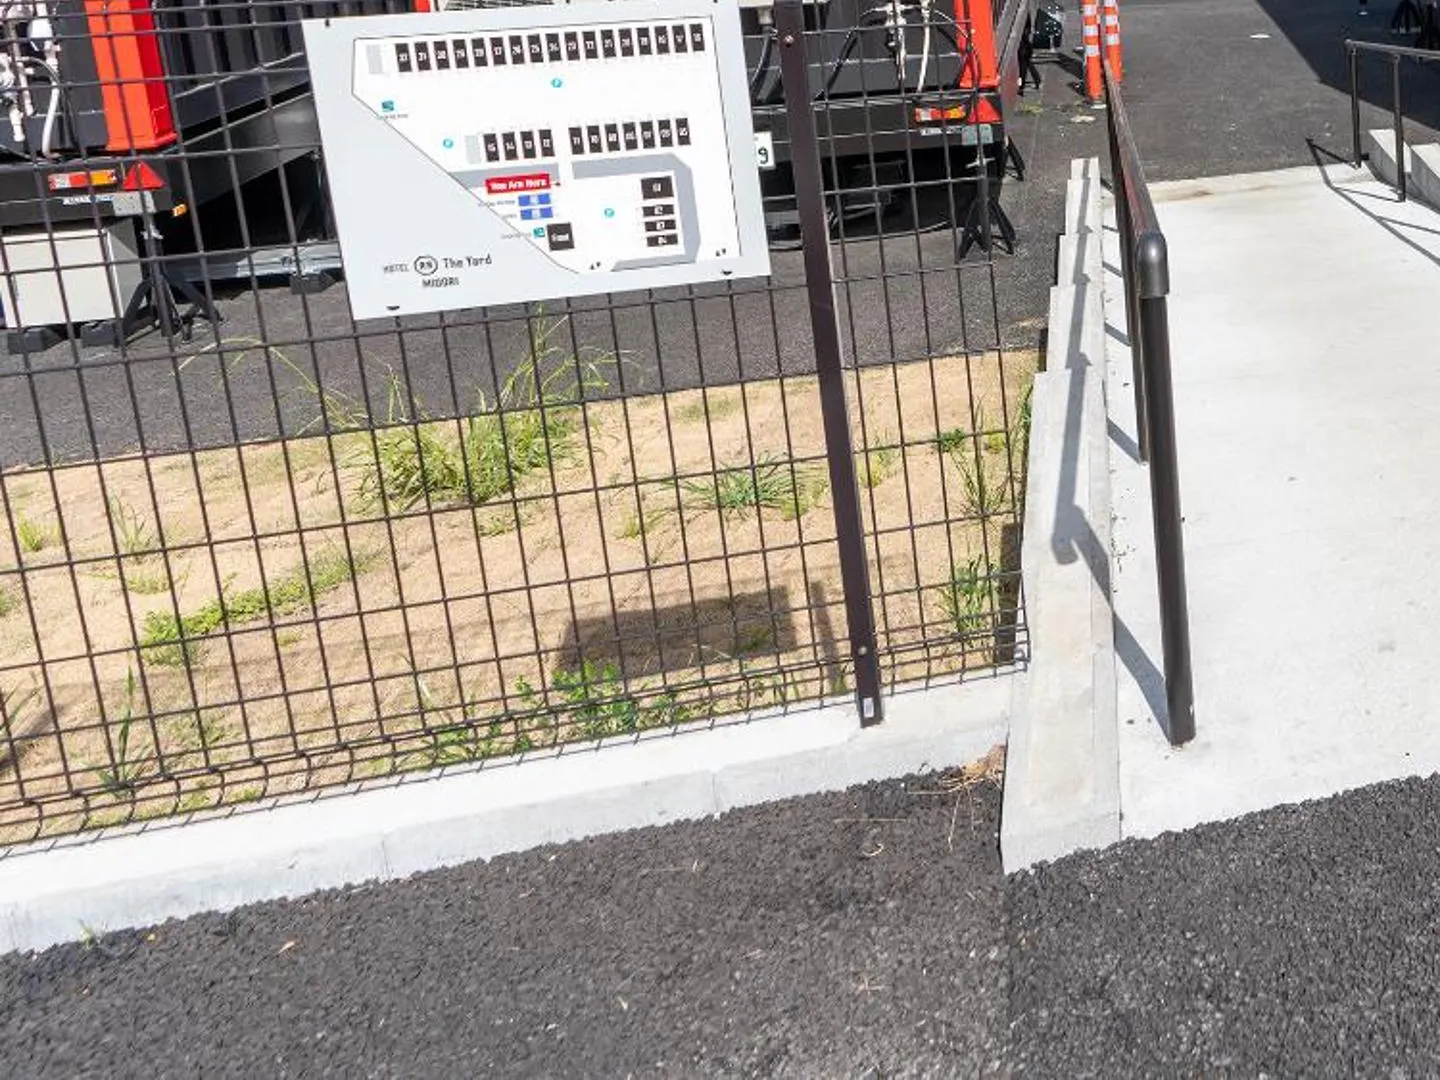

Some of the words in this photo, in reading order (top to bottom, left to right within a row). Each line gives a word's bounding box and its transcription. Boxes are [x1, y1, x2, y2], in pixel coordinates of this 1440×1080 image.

[508, 180, 524, 189] Are
[442, 257, 463, 268] The
[465, 253, 493, 267] Yard
